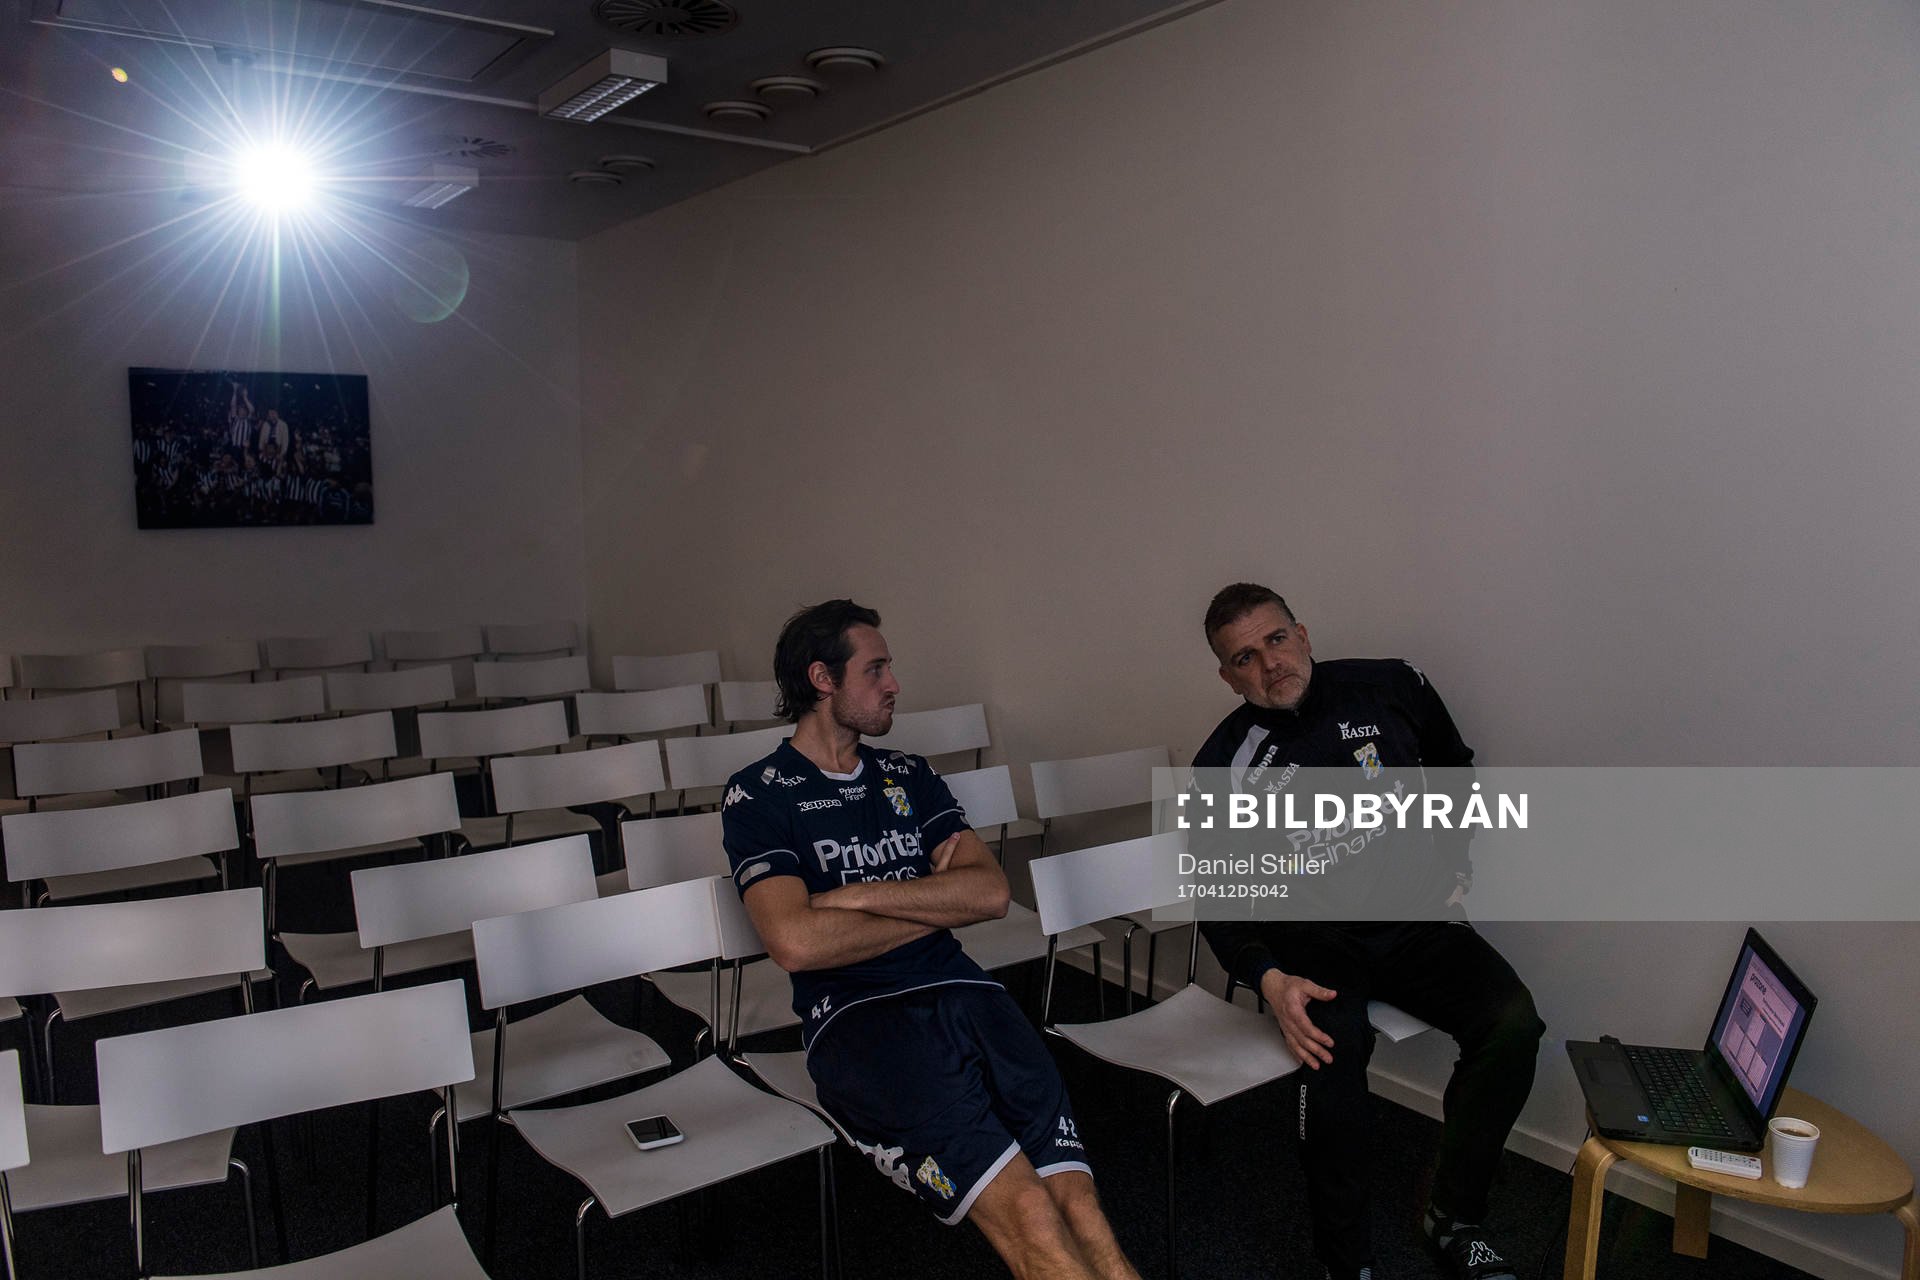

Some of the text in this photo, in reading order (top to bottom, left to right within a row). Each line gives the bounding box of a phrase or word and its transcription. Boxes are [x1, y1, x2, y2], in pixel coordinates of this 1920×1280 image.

[1341, 725, 1381, 740] RASTA
[880, 763, 910, 775] RATA
[1247, 745, 1279, 785] Kappa
[1271, 763, 1300, 794] RASTA
[797, 799, 843, 812] Kappa
[1286, 780, 1404, 852] Prioet
[813, 826, 924, 873] Prioritet
[811, 995, 832, 1019] 42
[1058, 1116, 1078, 1138] 42
